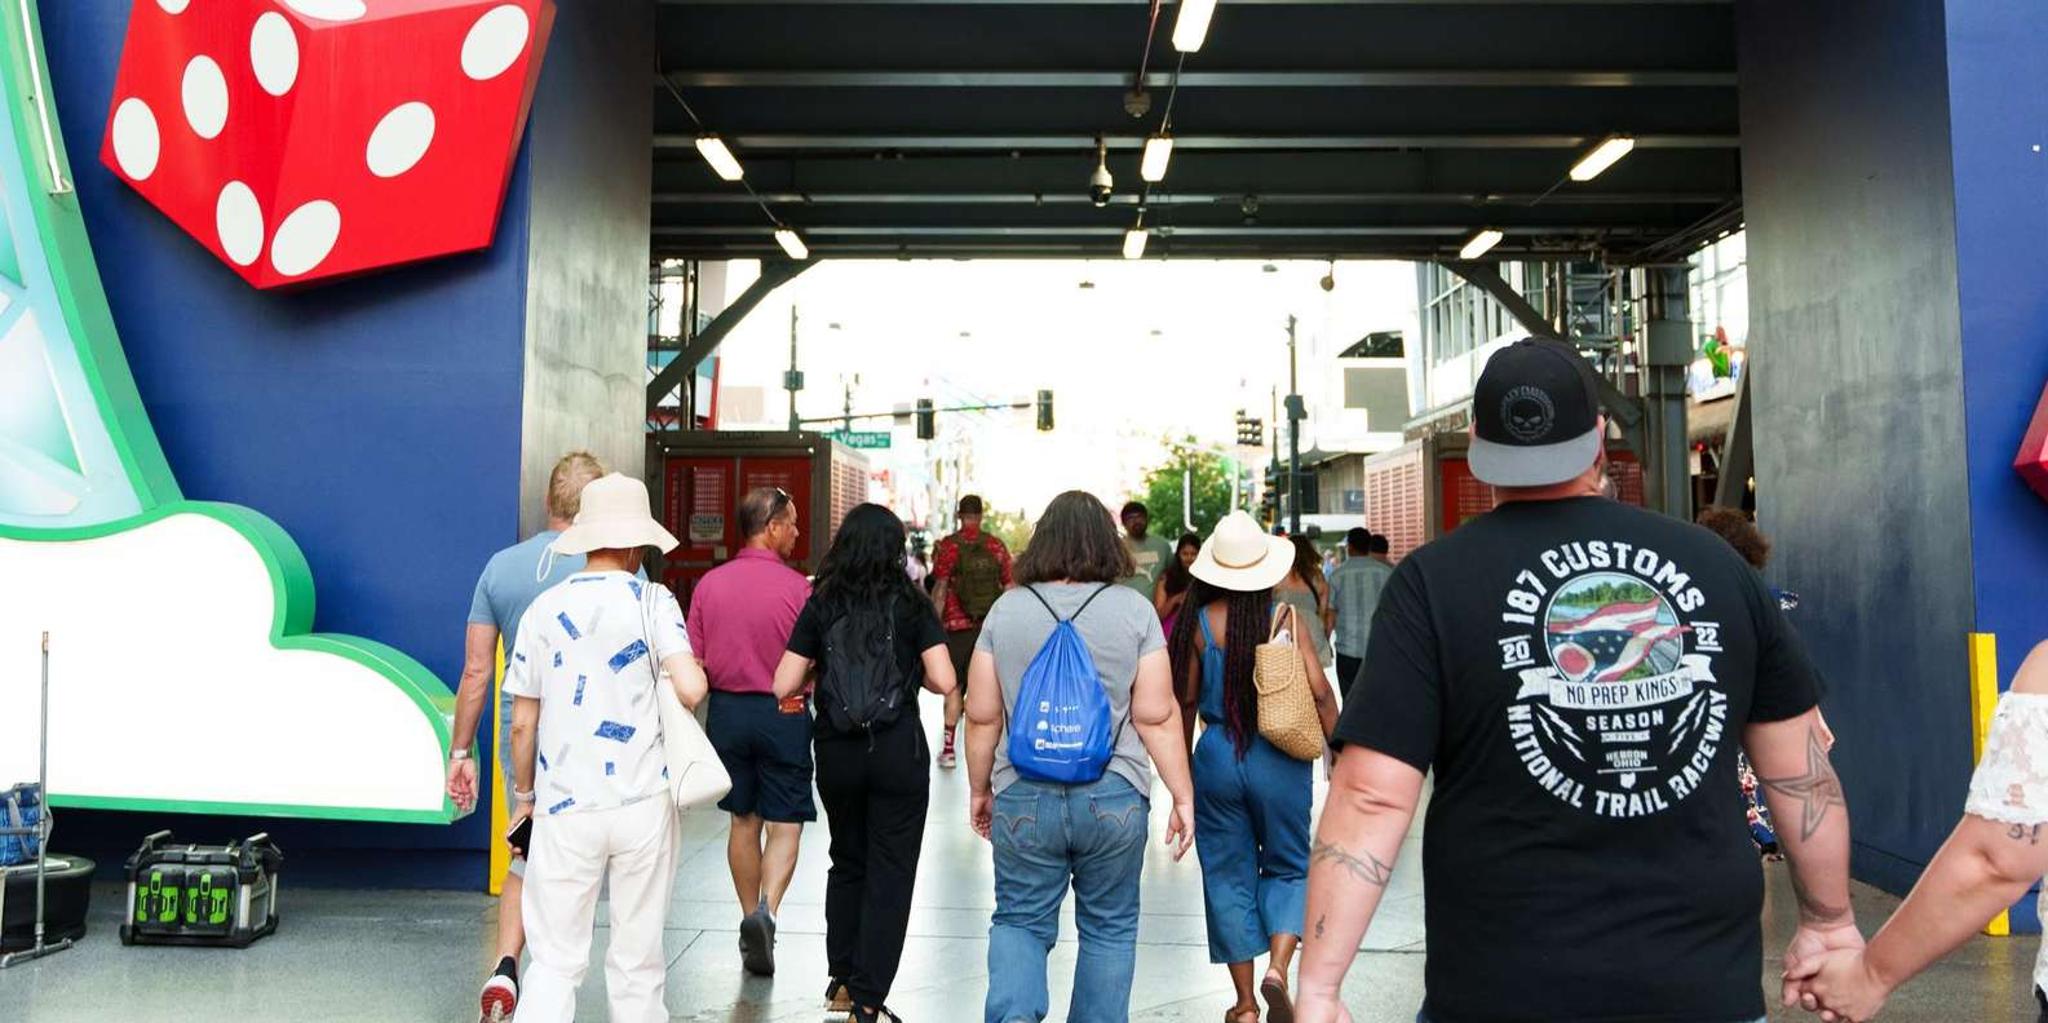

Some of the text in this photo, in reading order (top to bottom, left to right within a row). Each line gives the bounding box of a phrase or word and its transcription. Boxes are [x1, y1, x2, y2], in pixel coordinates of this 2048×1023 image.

[840, 432, 876, 447] Vegas
[1502, 540, 1705, 625] 187 CUSTOMS
[1695, 627, 1718, 646] 22
[1502, 640, 1530, 662] 20
[1566, 676, 1677, 705] NO PREP KINGS
[1586, 709, 1664, 731] SEASON
[1507, 689, 1727, 817] NATIONAL TRAIL RACEWAY
[1605, 750, 1648, 761] HEBRON
[1613, 759, 1641, 768] OHIO
